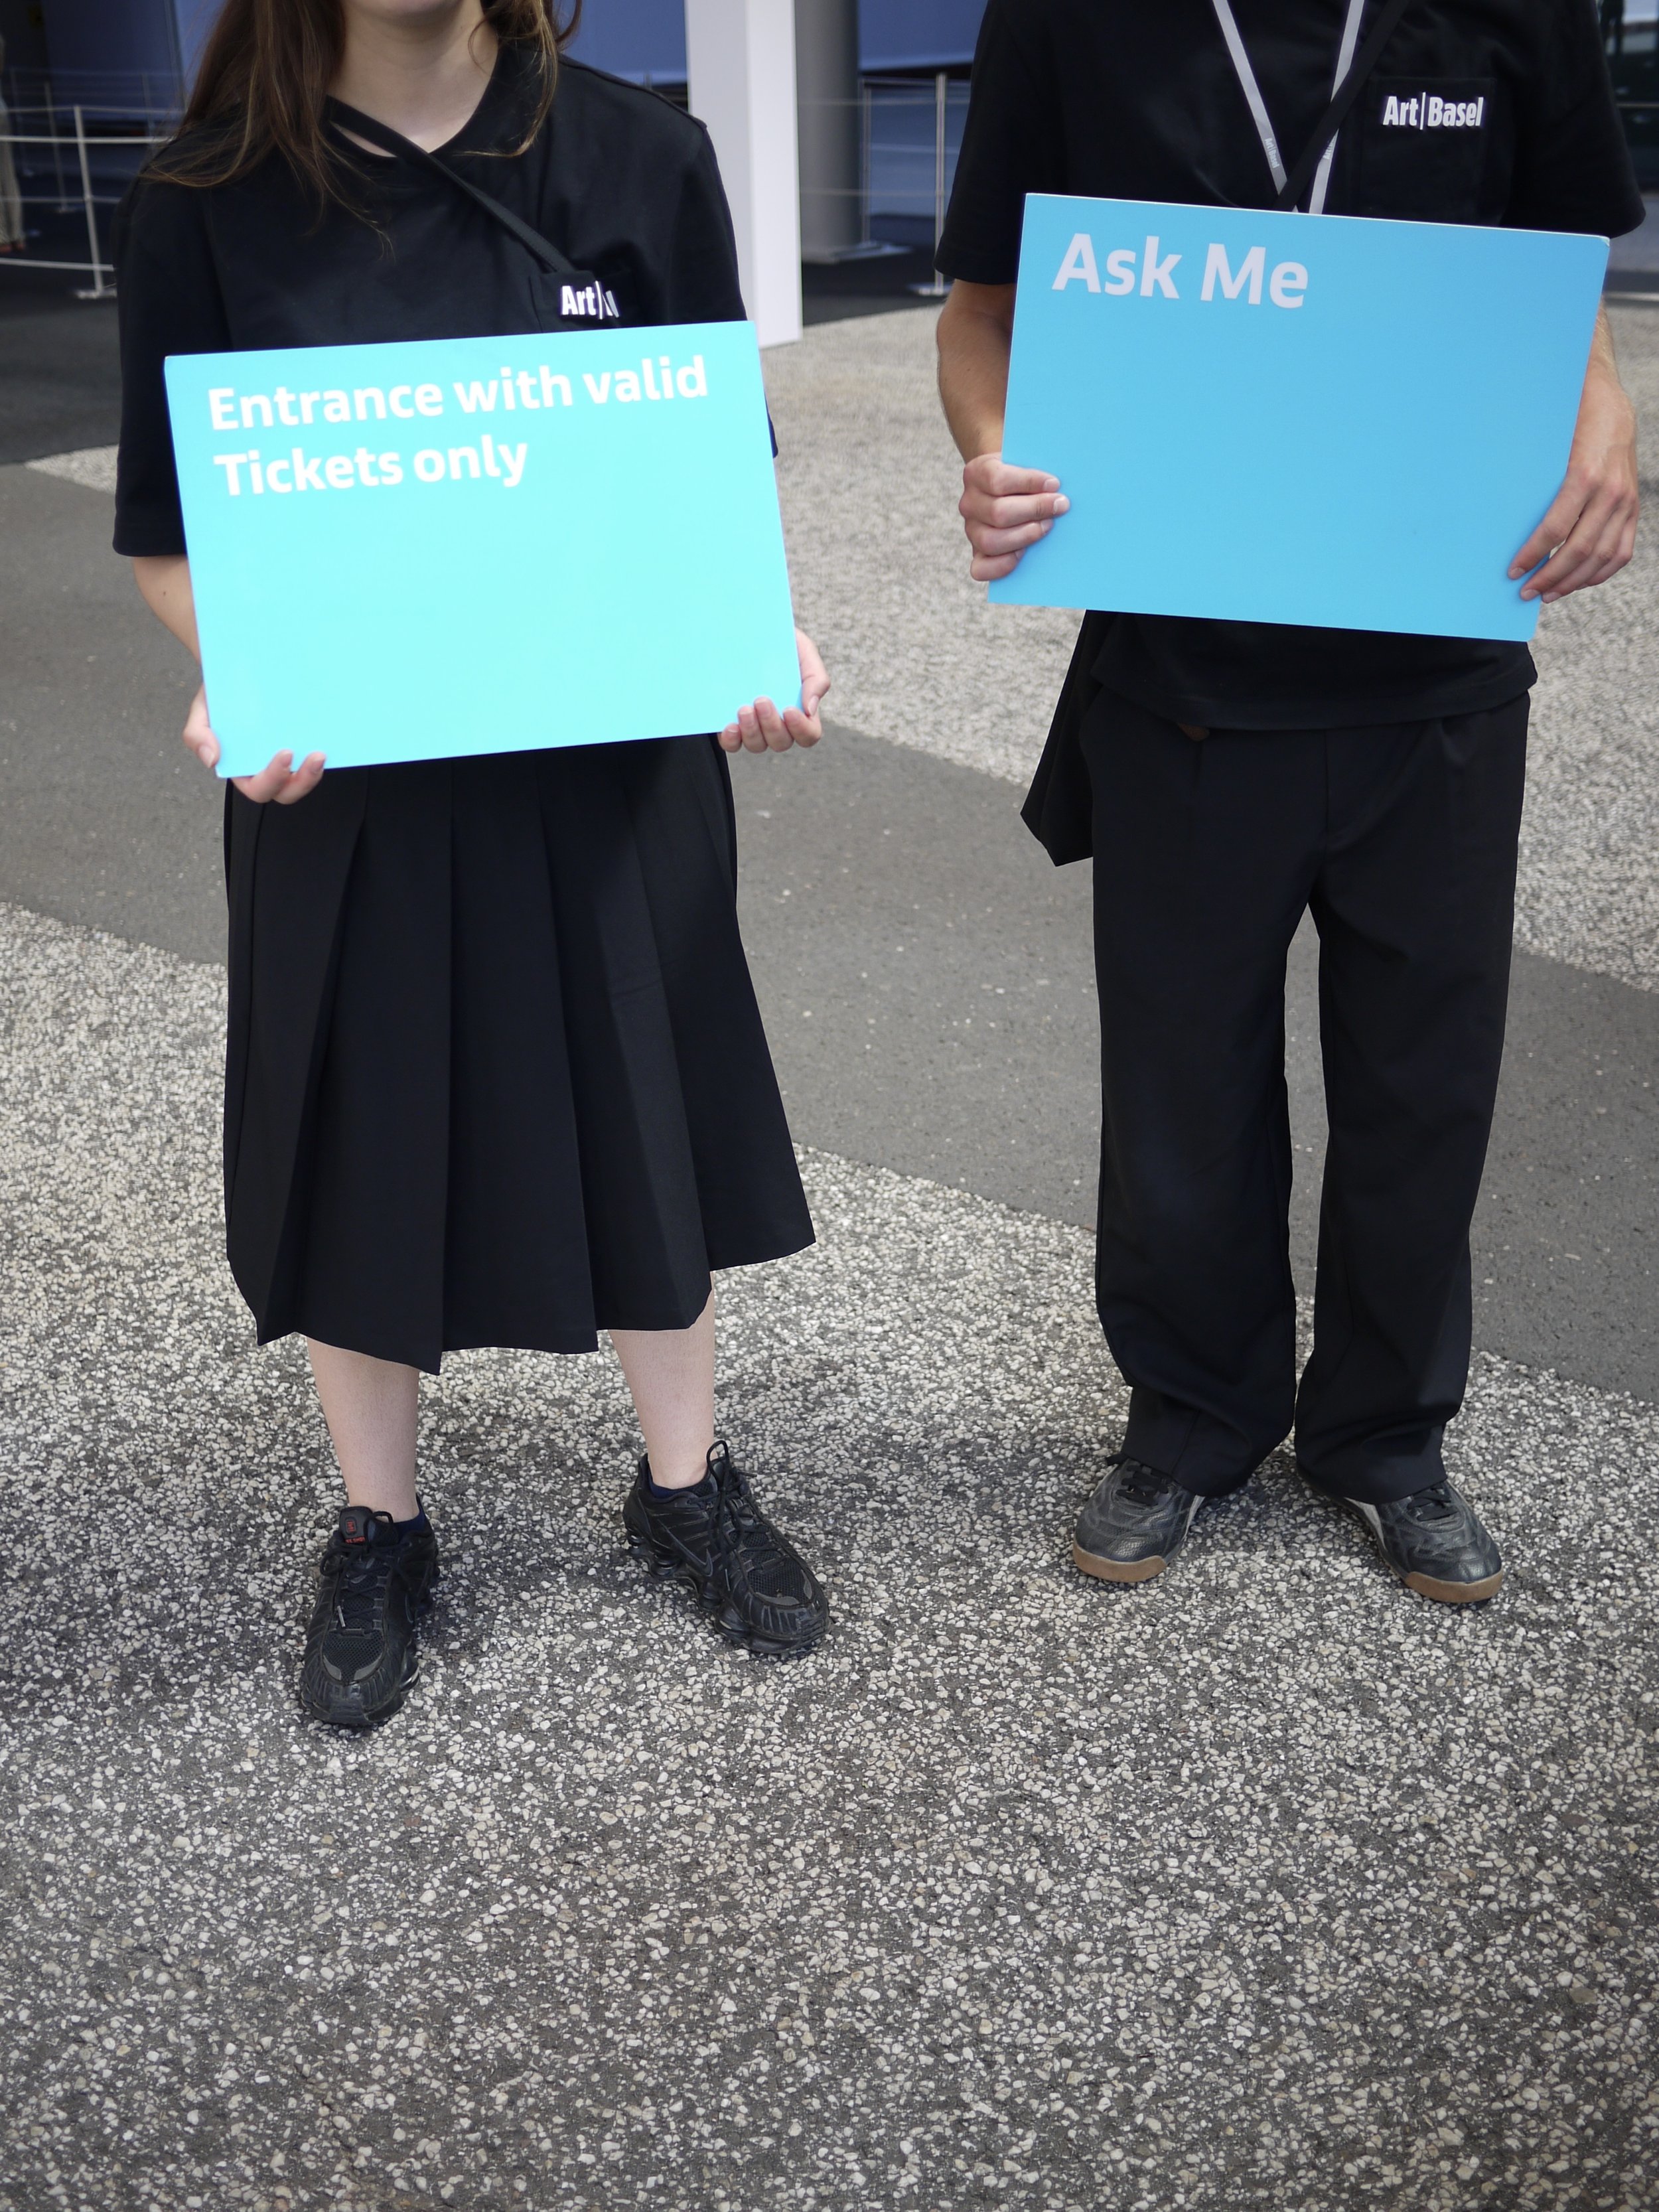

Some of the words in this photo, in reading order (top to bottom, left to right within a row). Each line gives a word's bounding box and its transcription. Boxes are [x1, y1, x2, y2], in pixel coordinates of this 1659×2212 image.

[1382, 96, 1419, 126] Art
[1427, 96, 1484, 127] Basel
[1052, 233, 1182, 299] Ask
[1200, 243, 1309, 309] Me
[208, 383, 443, 430] Entrance
[453, 366, 573, 413] with
[582, 354, 708, 404] valid
[213, 447, 403, 496] Tickets
[413, 434, 528, 488] only
